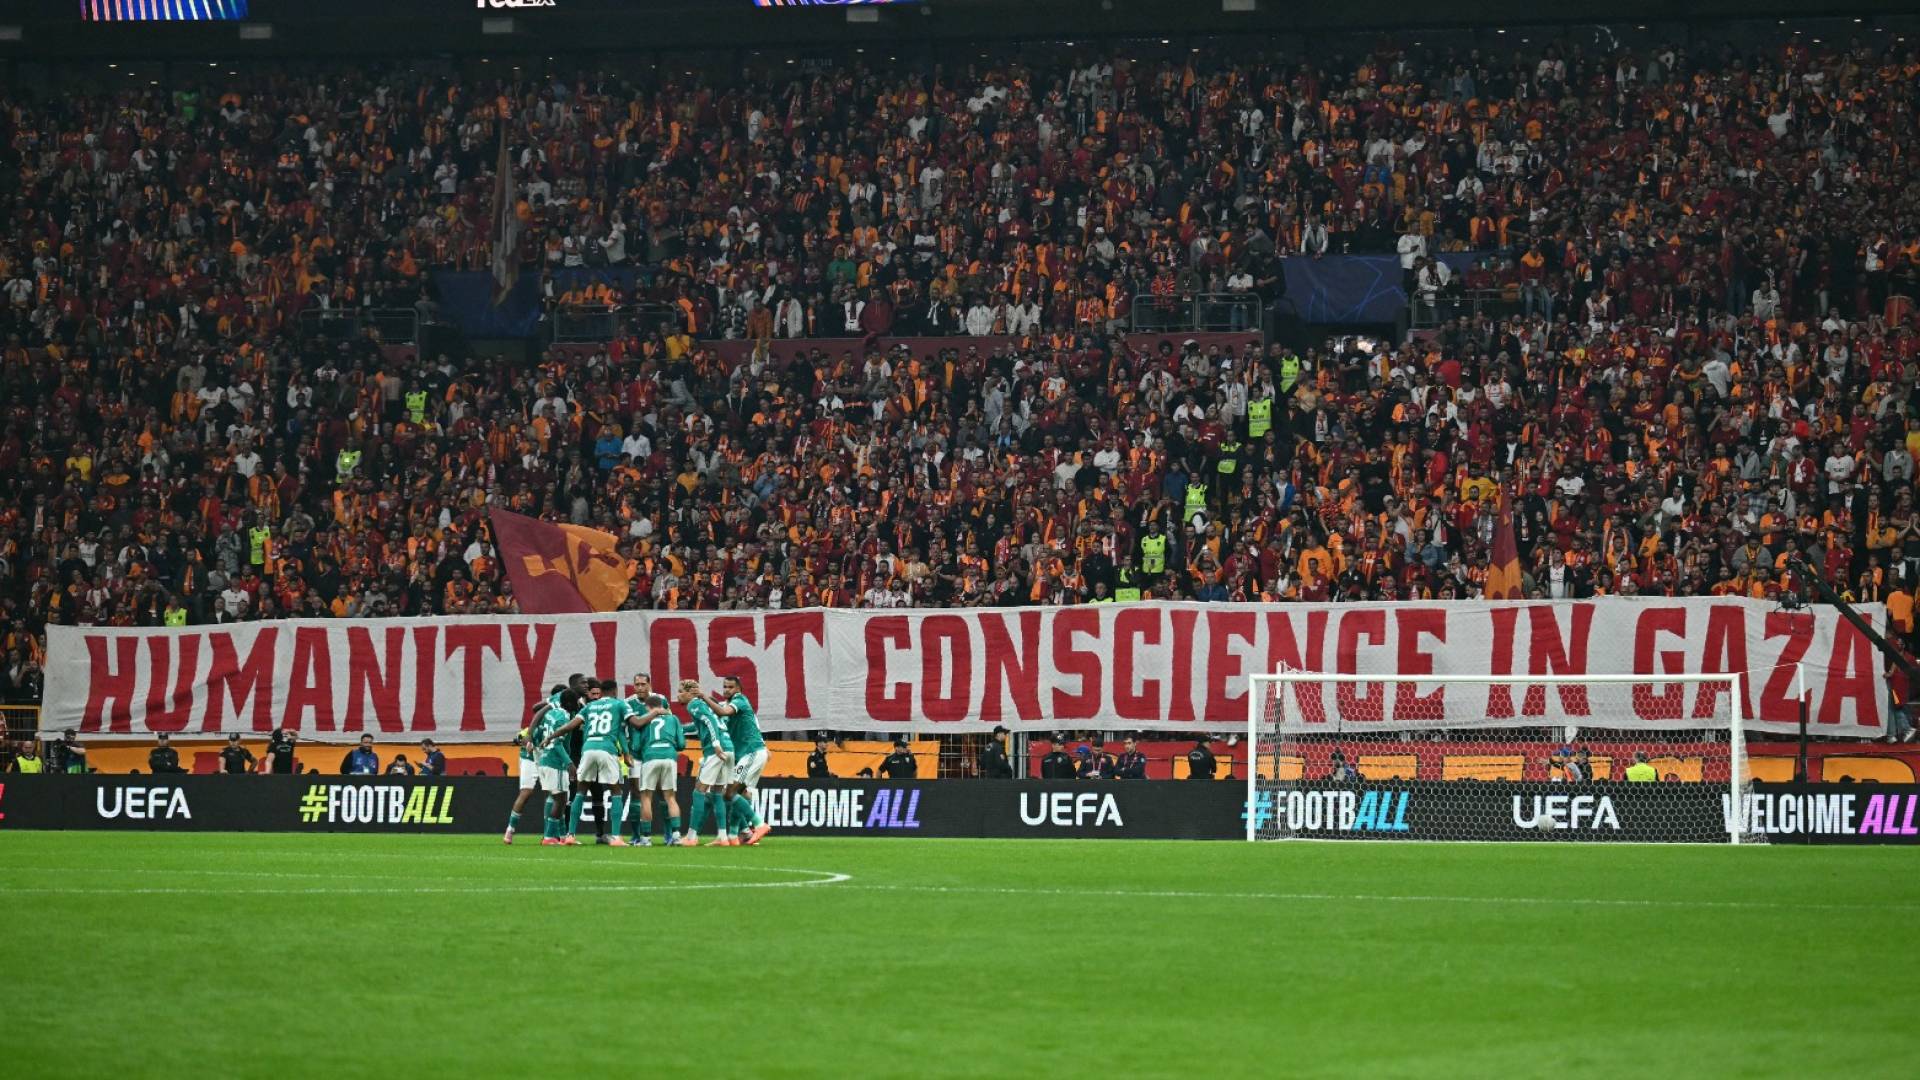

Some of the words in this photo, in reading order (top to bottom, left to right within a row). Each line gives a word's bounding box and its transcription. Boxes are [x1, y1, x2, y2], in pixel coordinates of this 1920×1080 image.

[80, 624, 556, 732] HUMANITY
[865, 608, 1446, 723] CONSCIENCE
[1486, 603, 1595, 716] IN
[1634, 605, 1880, 726] GAZA
[650, 718, 665, 740] 7
[96, 786, 192, 819] UEFA
[299, 785, 454, 824] #FOOTBALL
[750, 788, 864, 827] WELCOME
[865, 789, 921, 828] ALL
[1020, 792, 1124, 826] UEFA
[1241, 791, 1409, 831] #FOOTBALL
[1512, 794, 1620, 829] UEFA
[1722, 794, 1856, 834] WELCOME
[1858, 794, 1918, 834] ALL
